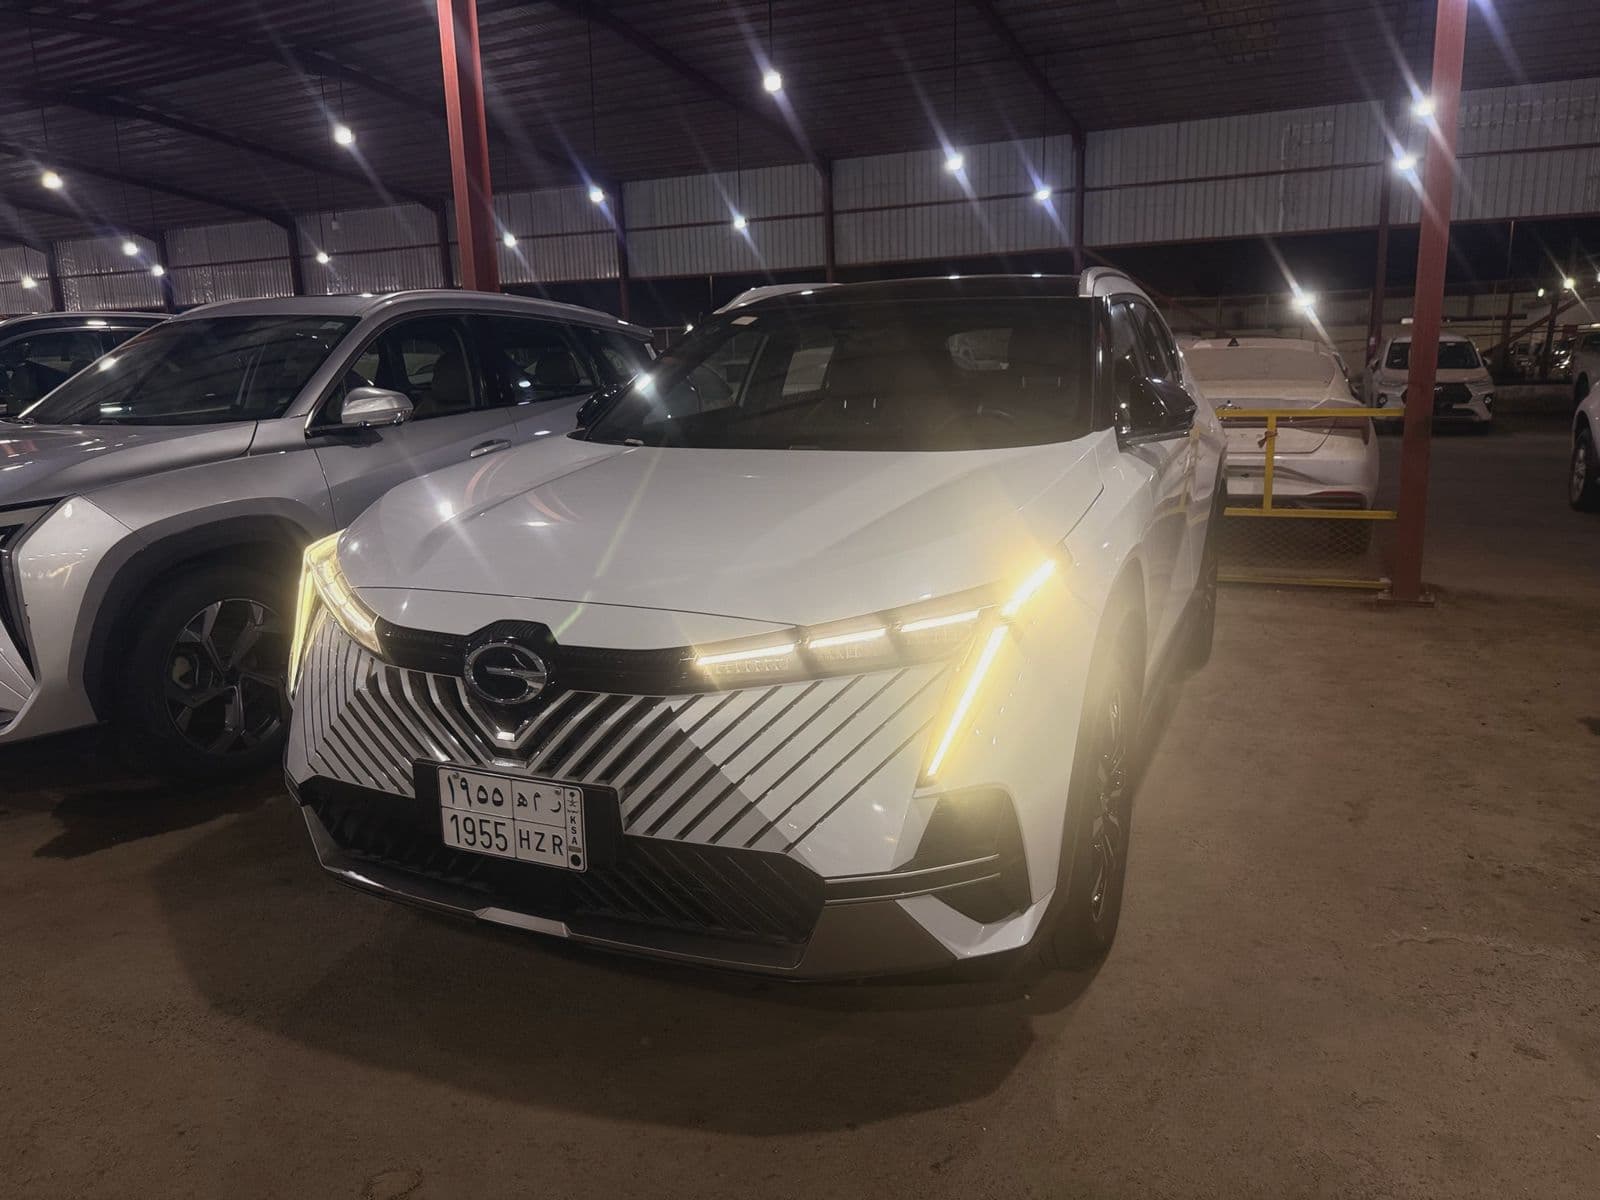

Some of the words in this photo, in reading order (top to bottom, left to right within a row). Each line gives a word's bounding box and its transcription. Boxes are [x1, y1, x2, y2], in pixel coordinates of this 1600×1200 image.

[450, 814, 508, 851] 1955
[519, 828, 564, 856] HZR
[570, 815, 578, 845] KSA
